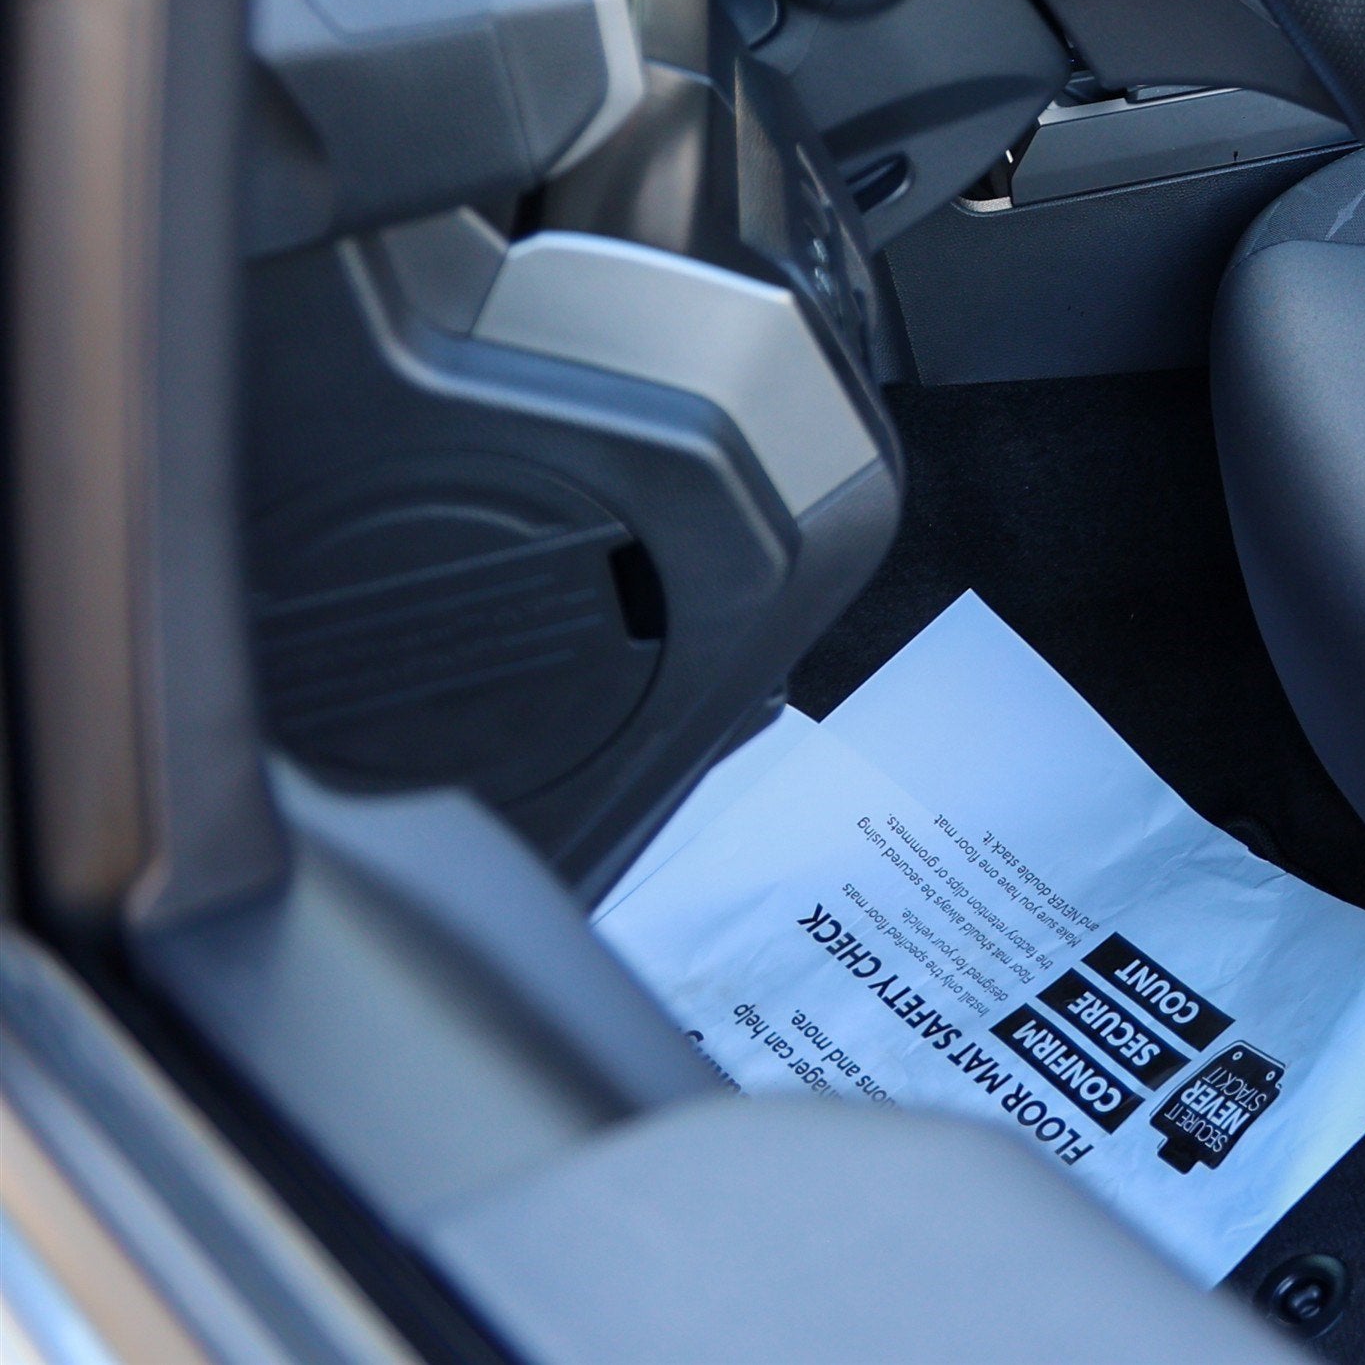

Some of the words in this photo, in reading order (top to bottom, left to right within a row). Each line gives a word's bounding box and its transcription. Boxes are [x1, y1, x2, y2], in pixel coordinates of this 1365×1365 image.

[857, 817, 886, 849] using
[934, 814, 957, 837] mat
[983, 830, 995, 845] it.
[887, 813, 940, 867] grommets.
[954, 837, 981, 863] floor
[881, 847, 923, 885] secured
[991, 841, 1019, 867] stack
[934, 867, 948, 878] or
[978, 859, 999, 878] one
[1017, 865, 1051, 896] double
[842, 883, 868, 908] mats
[920, 884, 936, 901] be
[945, 877, 969, 897] clips
[997, 877, 1022, 901] have
[864, 907, 889, 930] floor
[933, 896, 965, 924] always
[966, 896, 1008, 933] retention
[1018, 896, 1043, 914] you
[1047, 894, 1082, 921] NEVER
[902, 907, 934, 940] vehicle.
[1036, 911, 1059, 929] sure
[1075, 916, 1100, 931] and
[797, 903, 882, 978] CHECK
[883, 926, 928, 962] specified
[931, 938, 959, 958] your
[958, 922, 995, 950] should
[1004, 930, 1038, 958] factory
[1056, 926, 1082, 948] Make
[925, 960, 943, 978] the
[951, 955, 969, 971] for
[990, 947, 1012, 964] mat
[1035, 954, 1053, 970] the
[940, 974, 963, 993] only
[962, 966, 1008, 1001] designed
[1008, 963, 1035, 984] Floor
[957, 991, 990, 1018] Install
[1114, 959, 1199, 1023] COUNT
[731, 1001, 769, 1040] help
[868, 974, 962, 1050] SAFETY
[789, 1007, 833, 1052] more.
[1067, 991, 1160, 1066] SECURE
[761, 1029, 795, 1062] can
[820, 1046, 861, 1077] and
[947, 1042, 1013, 1094] MAT
[1012, 1020, 1121, 1112] CONFIRM
[1202, 1066, 1227, 1084] IT
[1215, 1072, 1267, 1111] STACK
[1164, 1103, 1184, 1120] IT
[1181, 1080, 1250, 1135] NEVER
[1001, 1082, 1094, 1166] FLOOR
[1175, 1109, 1228, 1152] SECURE
